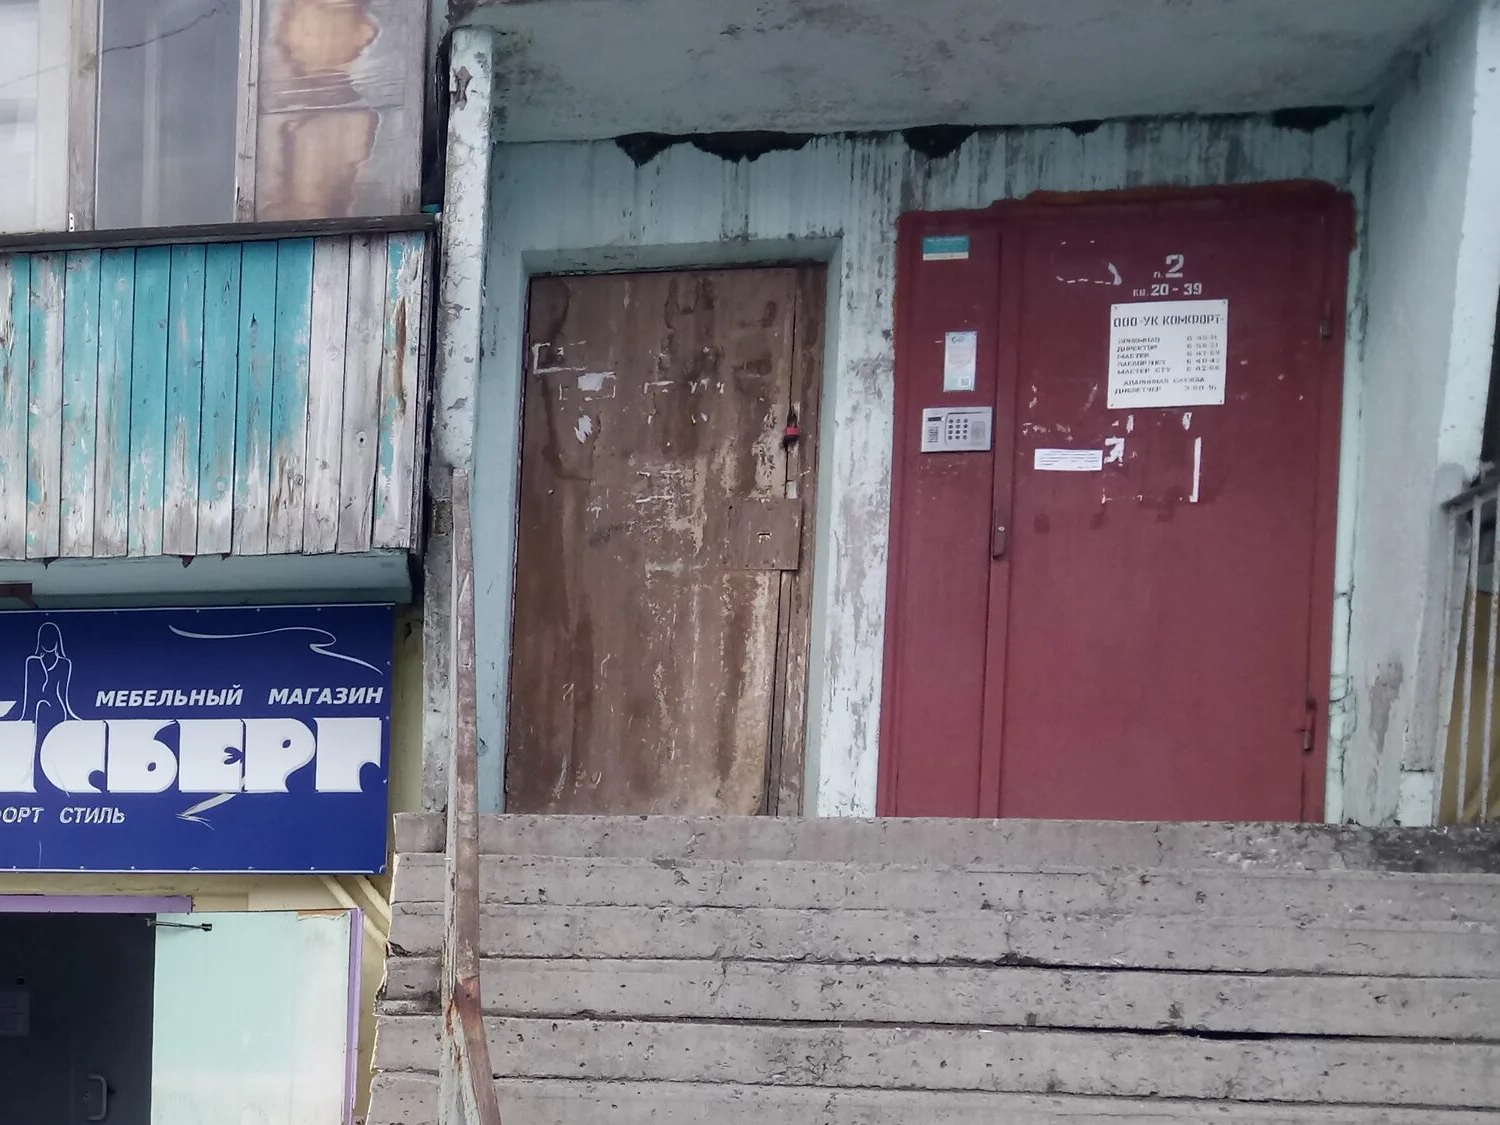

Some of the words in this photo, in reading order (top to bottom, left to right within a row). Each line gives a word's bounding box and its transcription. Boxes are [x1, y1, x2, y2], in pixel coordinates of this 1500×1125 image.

[95, 684, 243, 707] МЕБЕЛЬНЫЙ
[268, 686, 384, 706] МАГАЗИН
[59, 806, 127, 825] СТИЛЬ
